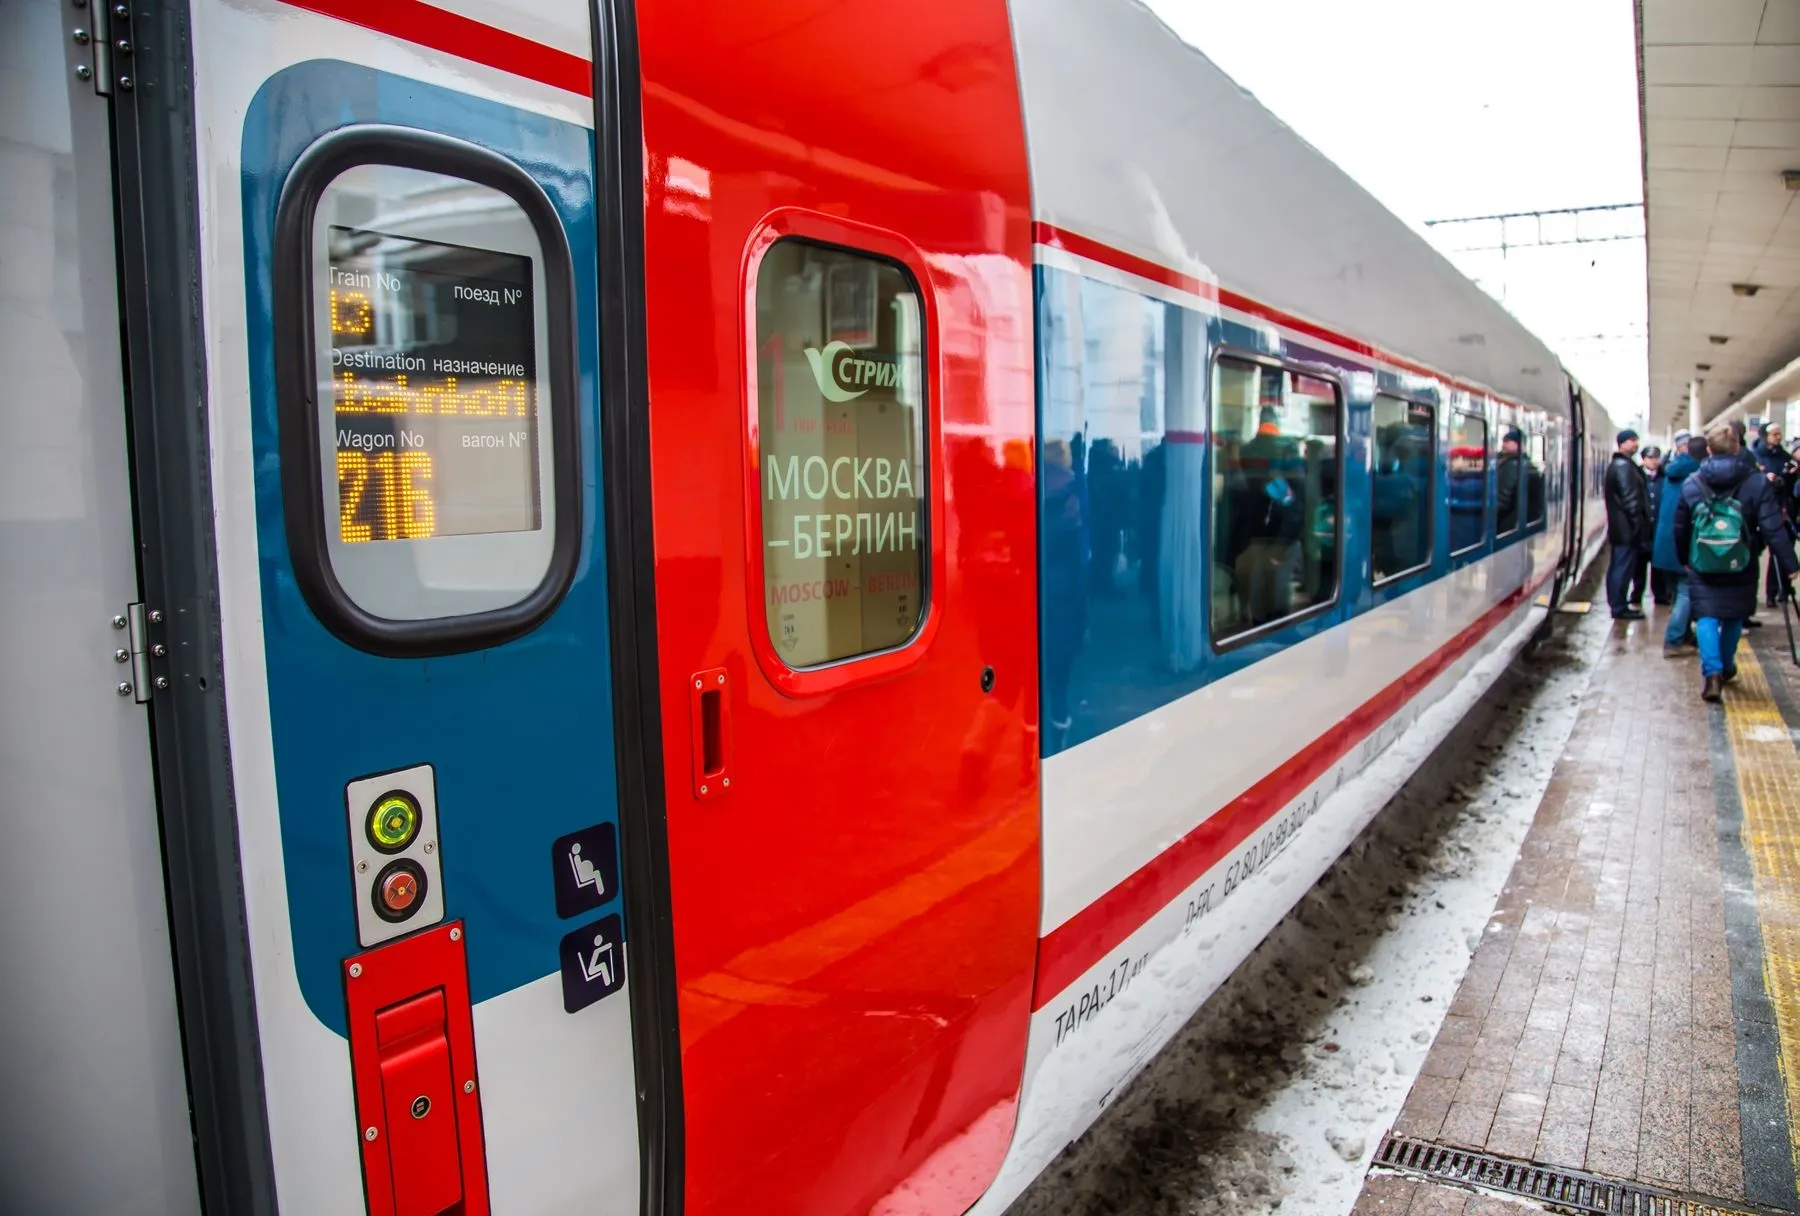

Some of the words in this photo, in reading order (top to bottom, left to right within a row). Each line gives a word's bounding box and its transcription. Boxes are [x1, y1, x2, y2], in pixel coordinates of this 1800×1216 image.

[328, 266, 371, 289] Train
[376, 271, 401, 292] No
[454, 285, 500, 306] поезд
[331, 348, 426, 372] Destination
[432, 358, 525, 377] назначение
[334, 429, 395, 451] Wagon
[400, 430, 425, 448] No
[461, 434, 505, 449] вагон
[766, 454, 915, 501] МОСКВА
[337, 451, 435, 543] 216
[770, 578, 849, 606] MOSCOW
[867, 570, 917, 594] BERLIN
[1224, 860, 1240, 897] 62
[1241, 845, 1257, 881] 80
